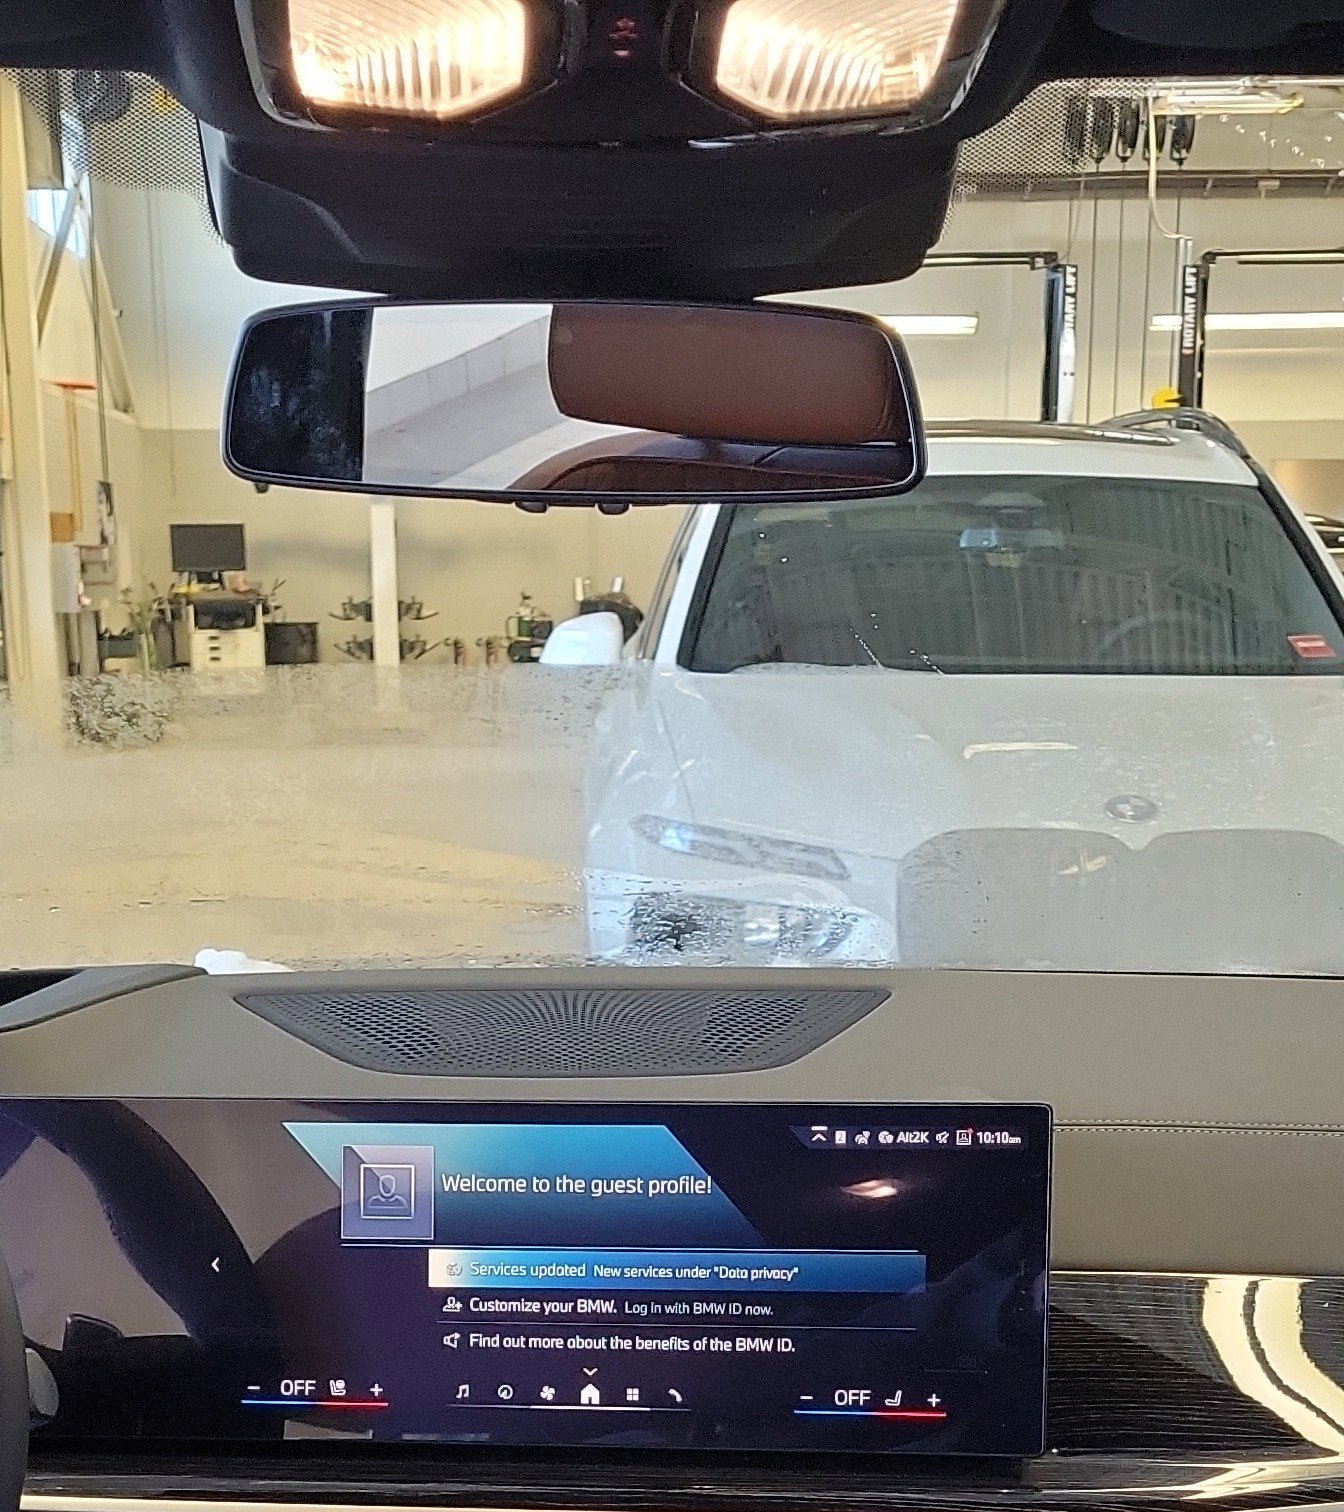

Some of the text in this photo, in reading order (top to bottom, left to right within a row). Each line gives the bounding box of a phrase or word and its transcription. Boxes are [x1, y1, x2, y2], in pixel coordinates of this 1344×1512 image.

[1182, 266, 1198, 348] ROTARY LIFT
[441, 1173, 713, 1198] Welcome to the guest profile!
[469, 1262, 527, 1277] Services
[530, 1263, 587, 1279] updated
[593, 1265, 622, 1278] New
[623, 1265, 673, 1279] services
[675, 1266, 711, 1279] under
[469, 1298, 774, 1317] Customize your BMW. Log in with BMW ID now.
[469, 1334, 796, 1353] Find out more about the benefits of the BMW ID.
[280, 1379, 317, 1396] OFF
[834, 1389, 872, 1406] OFF
